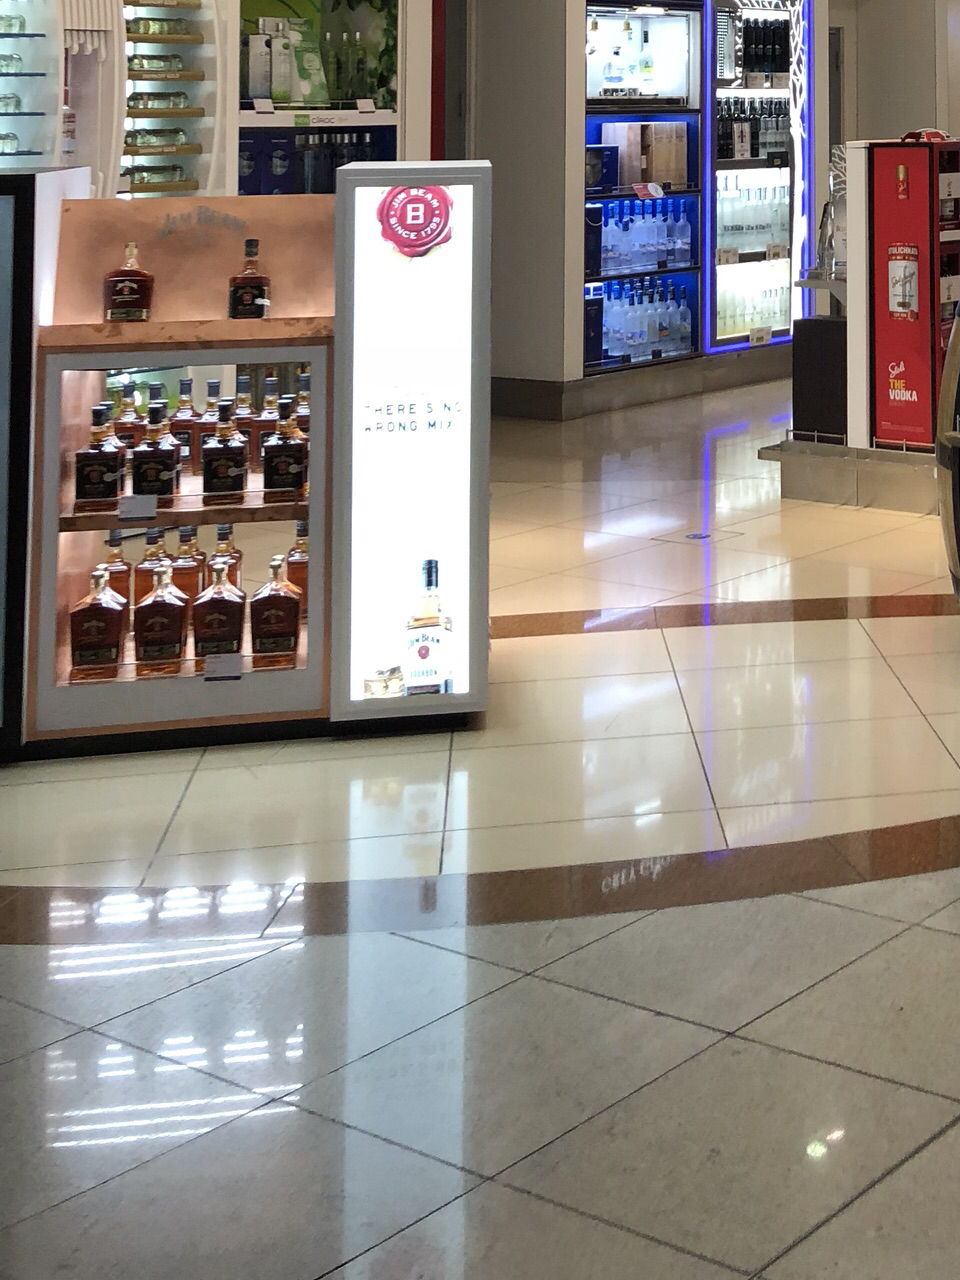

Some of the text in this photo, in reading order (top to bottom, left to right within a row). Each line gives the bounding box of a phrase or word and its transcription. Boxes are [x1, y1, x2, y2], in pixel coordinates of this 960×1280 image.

[391, 188, 440, 209] JIM BEAM
[406, 203, 425, 225] B
[389, 216, 441, 240] SINCE 1795
[889, 378, 906, 390] THE
[888, 389, 918, 402] VODKA
